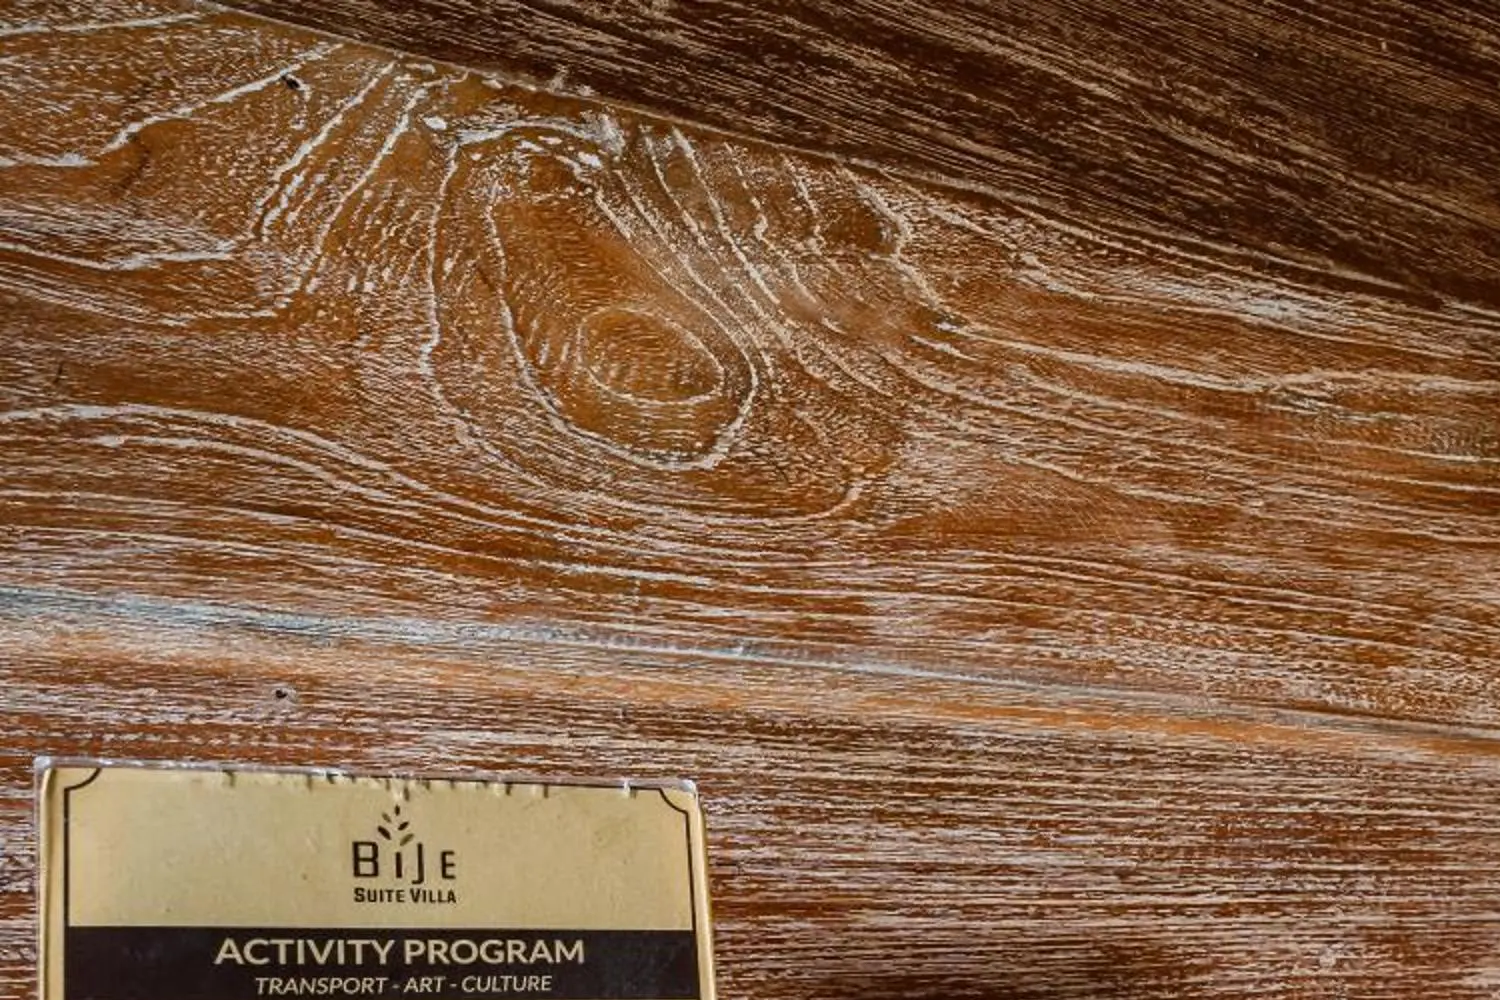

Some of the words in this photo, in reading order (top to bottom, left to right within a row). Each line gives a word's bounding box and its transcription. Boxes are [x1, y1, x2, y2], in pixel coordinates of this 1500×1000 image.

[213, 938, 395, 966] ACTIVITY
[403, 938, 585, 965] PROGRAM
[255, 977, 388, 995] TRANSPORT
[403, 976, 446, 994] ART
[461, 975, 553, 993] CULTURE
